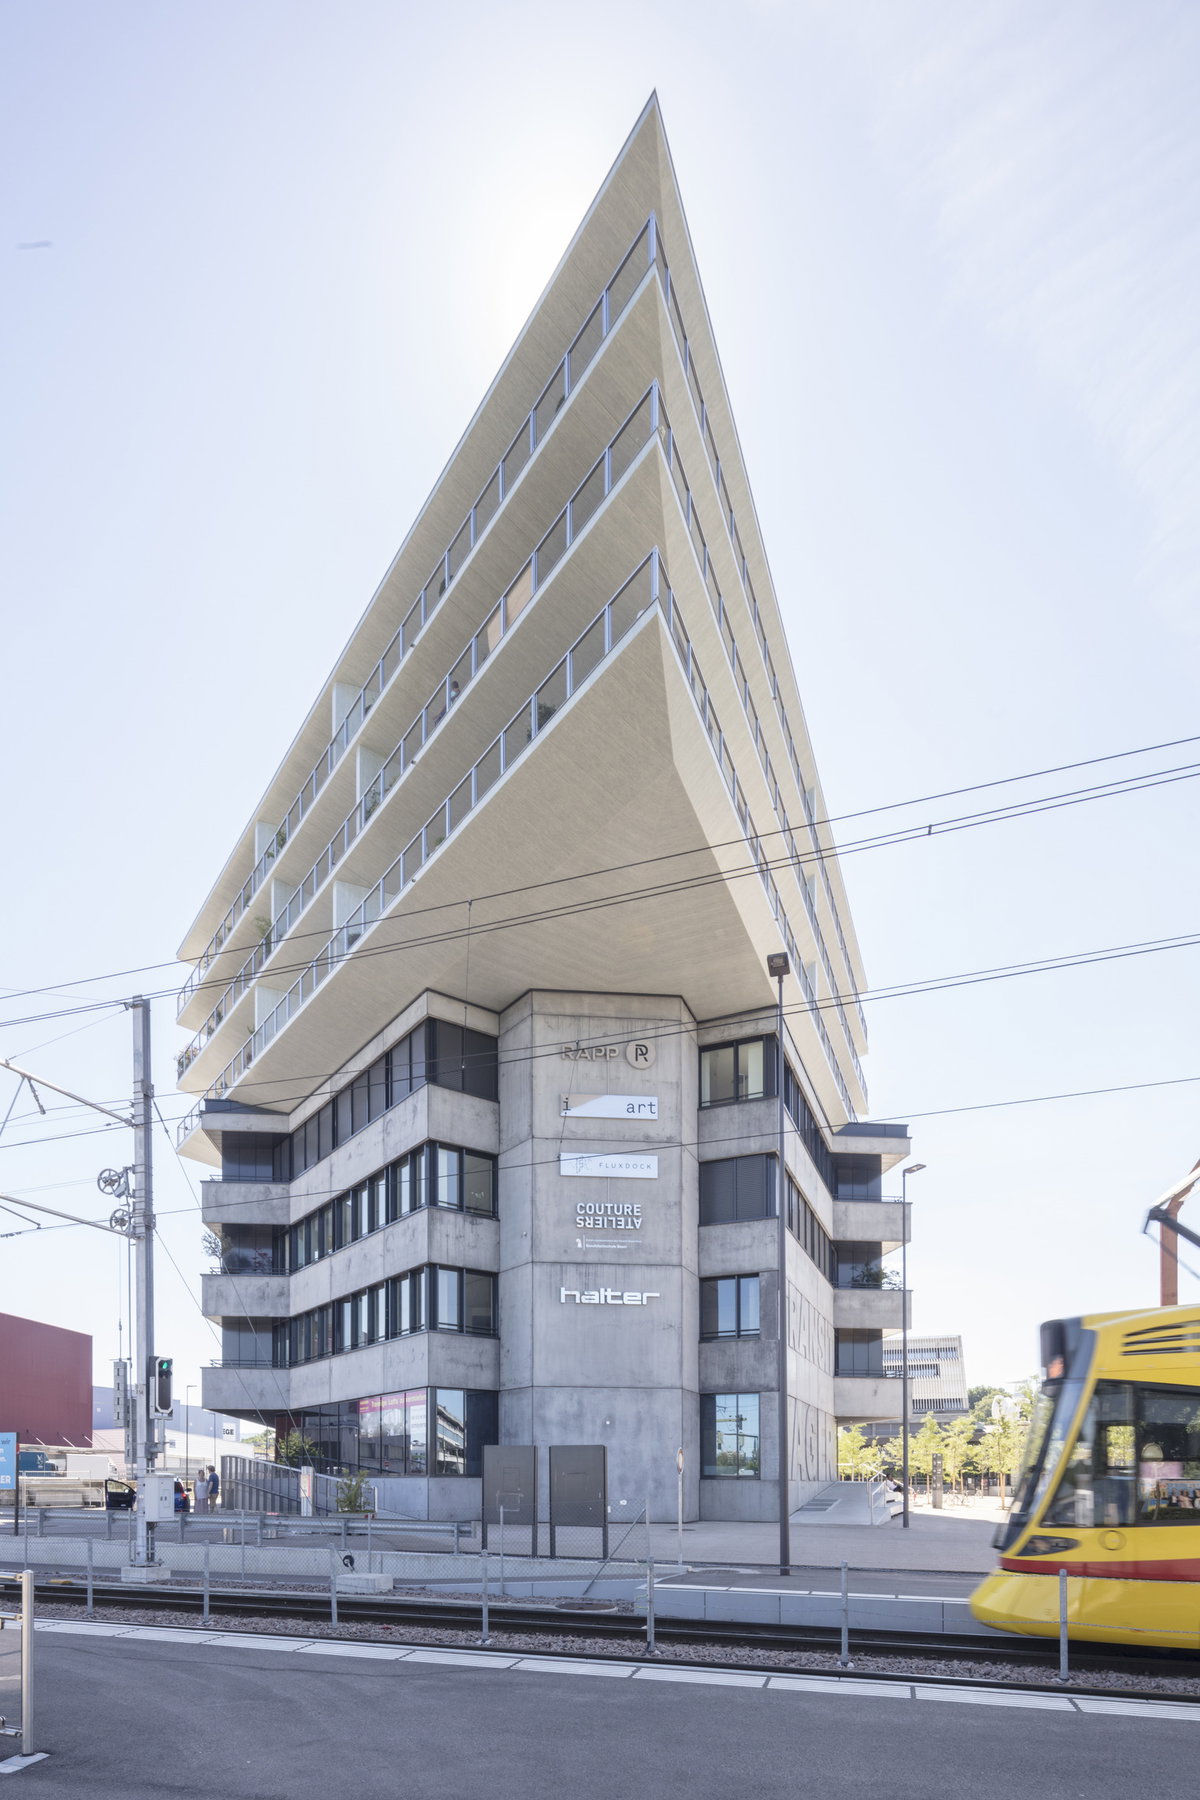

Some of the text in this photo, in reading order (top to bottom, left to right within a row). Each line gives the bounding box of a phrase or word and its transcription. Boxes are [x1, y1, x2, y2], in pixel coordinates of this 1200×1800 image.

[561, 1044, 619, 1061] RAPP
[626, 1101, 657, 1115] art
[598, 1161, 652, 1171] FLUXDOCK
[576, 1202, 642, 1216] COUTURE
[576, 1216, 642, 1229] ATELIERS
[560, 1287, 660, 1305] halter
